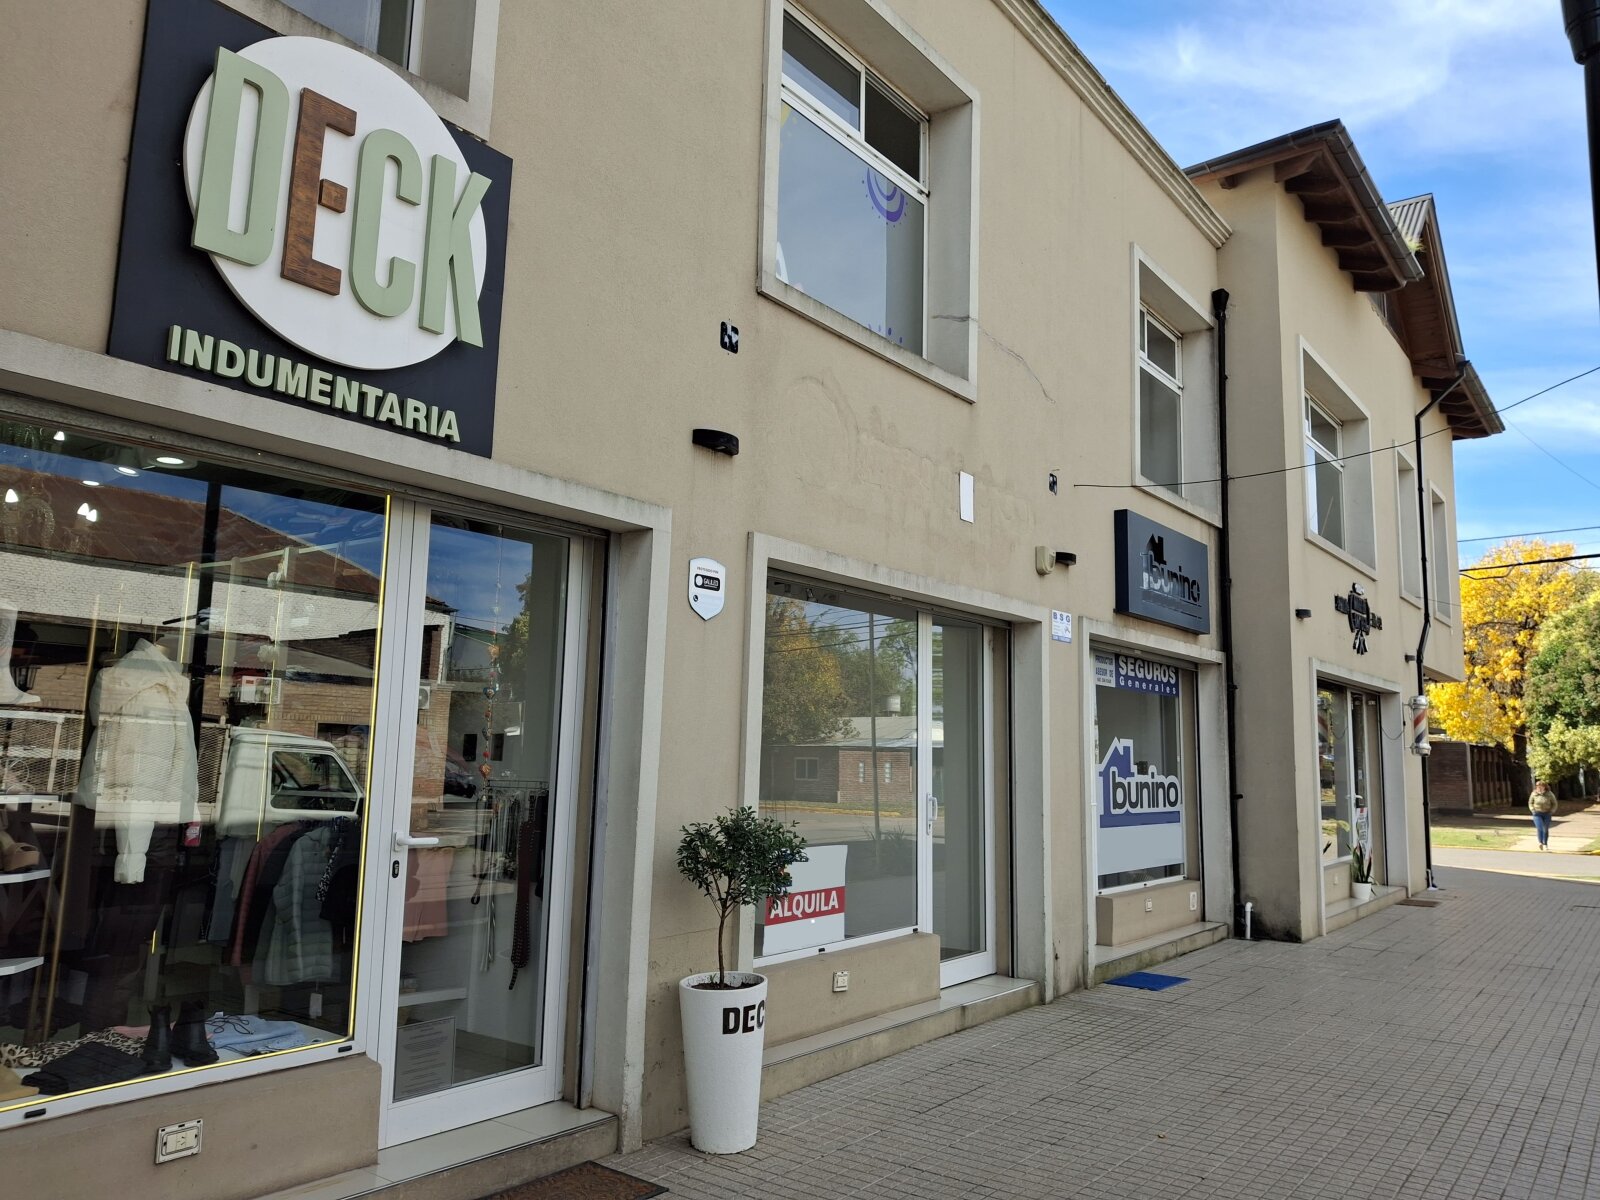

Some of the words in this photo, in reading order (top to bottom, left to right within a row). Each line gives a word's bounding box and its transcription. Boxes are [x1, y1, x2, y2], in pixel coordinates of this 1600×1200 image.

[191, 46, 492, 348] DECK
[167, 324, 461, 443] INDUMENTARIA
[1118, 655, 1177, 685] SEGUROS
[1119, 675, 1177, 695] Generales
[1112, 770, 1179, 810] bunino
[770, 890, 839, 919] ALQUILA
[722, 999, 765, 1035] DEC
